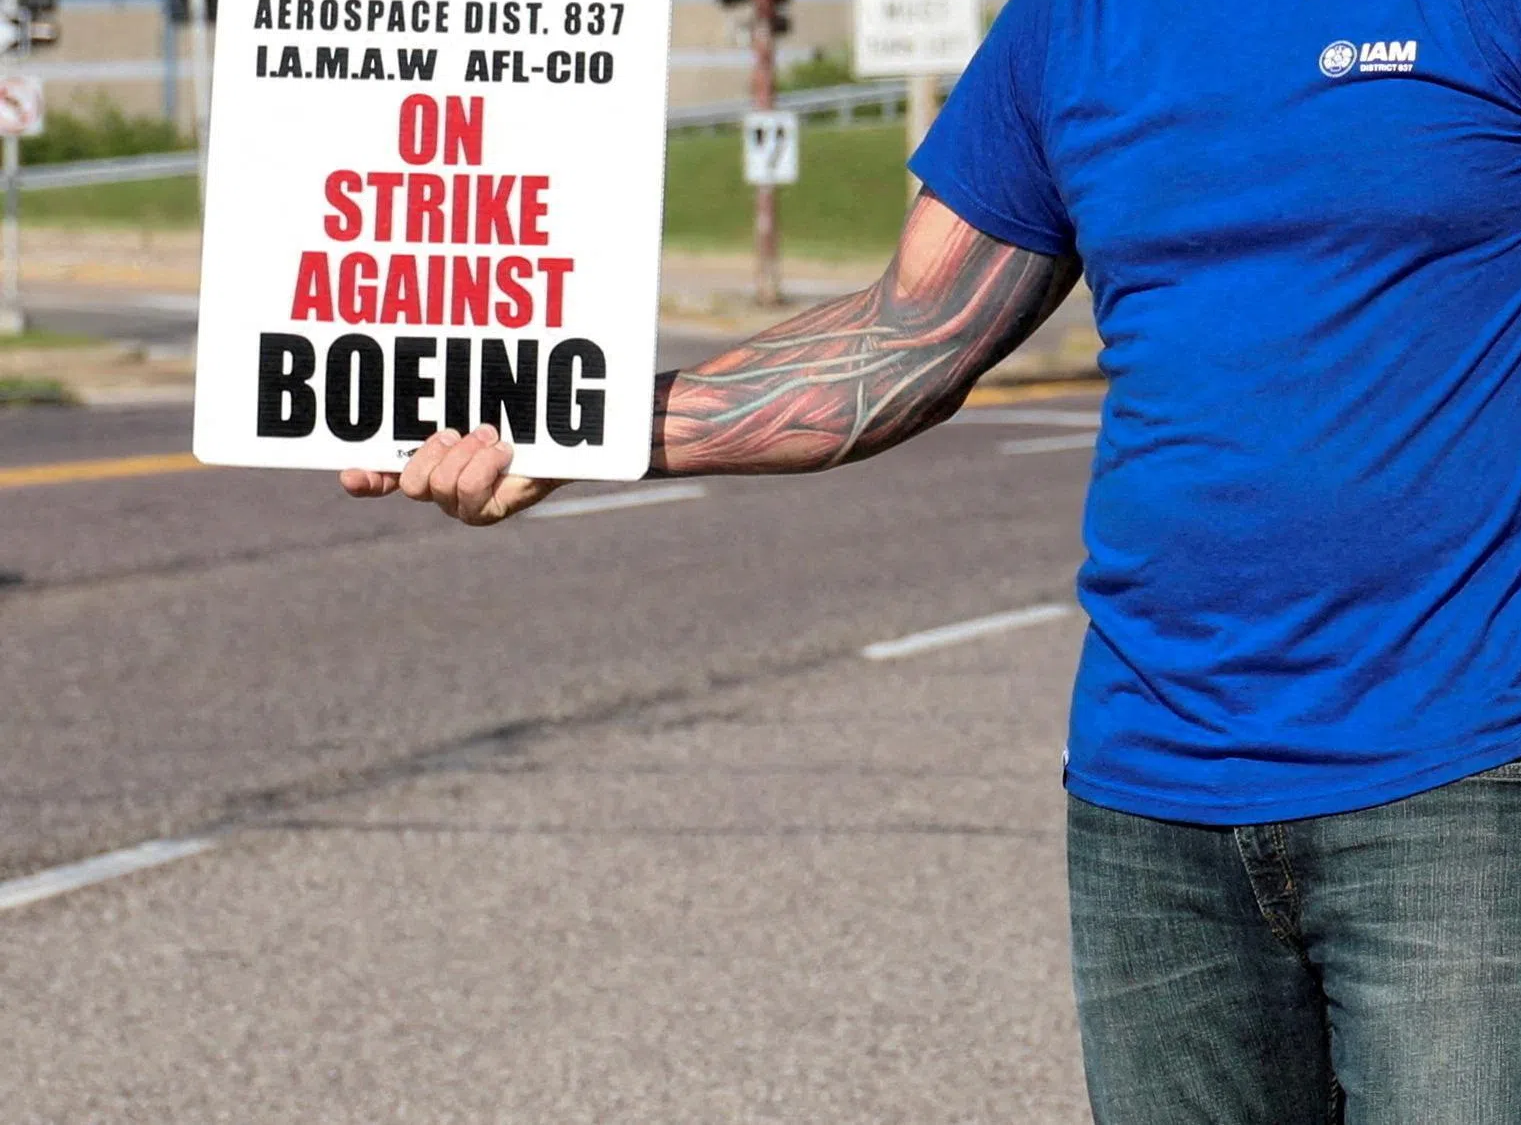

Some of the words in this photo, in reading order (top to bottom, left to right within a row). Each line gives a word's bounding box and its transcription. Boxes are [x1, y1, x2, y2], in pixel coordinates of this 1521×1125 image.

[465, 1, 549, 35] DIST.
[565, 3, 624, 35] 837
[257, 45, 438, 80] I.A.M.A.W
[465, 50, 614, 83] AFL-CIO
[1360, 40, 1417, 62] IAM
[1360, 63, 1397, 72] DISTRICT
[398, 93, 484, 166] ON
[324, 170, 549, 246] STRIKE
[291, 251, 574, 329] AGAINST
[257, 333, 606, 447] BOEING
